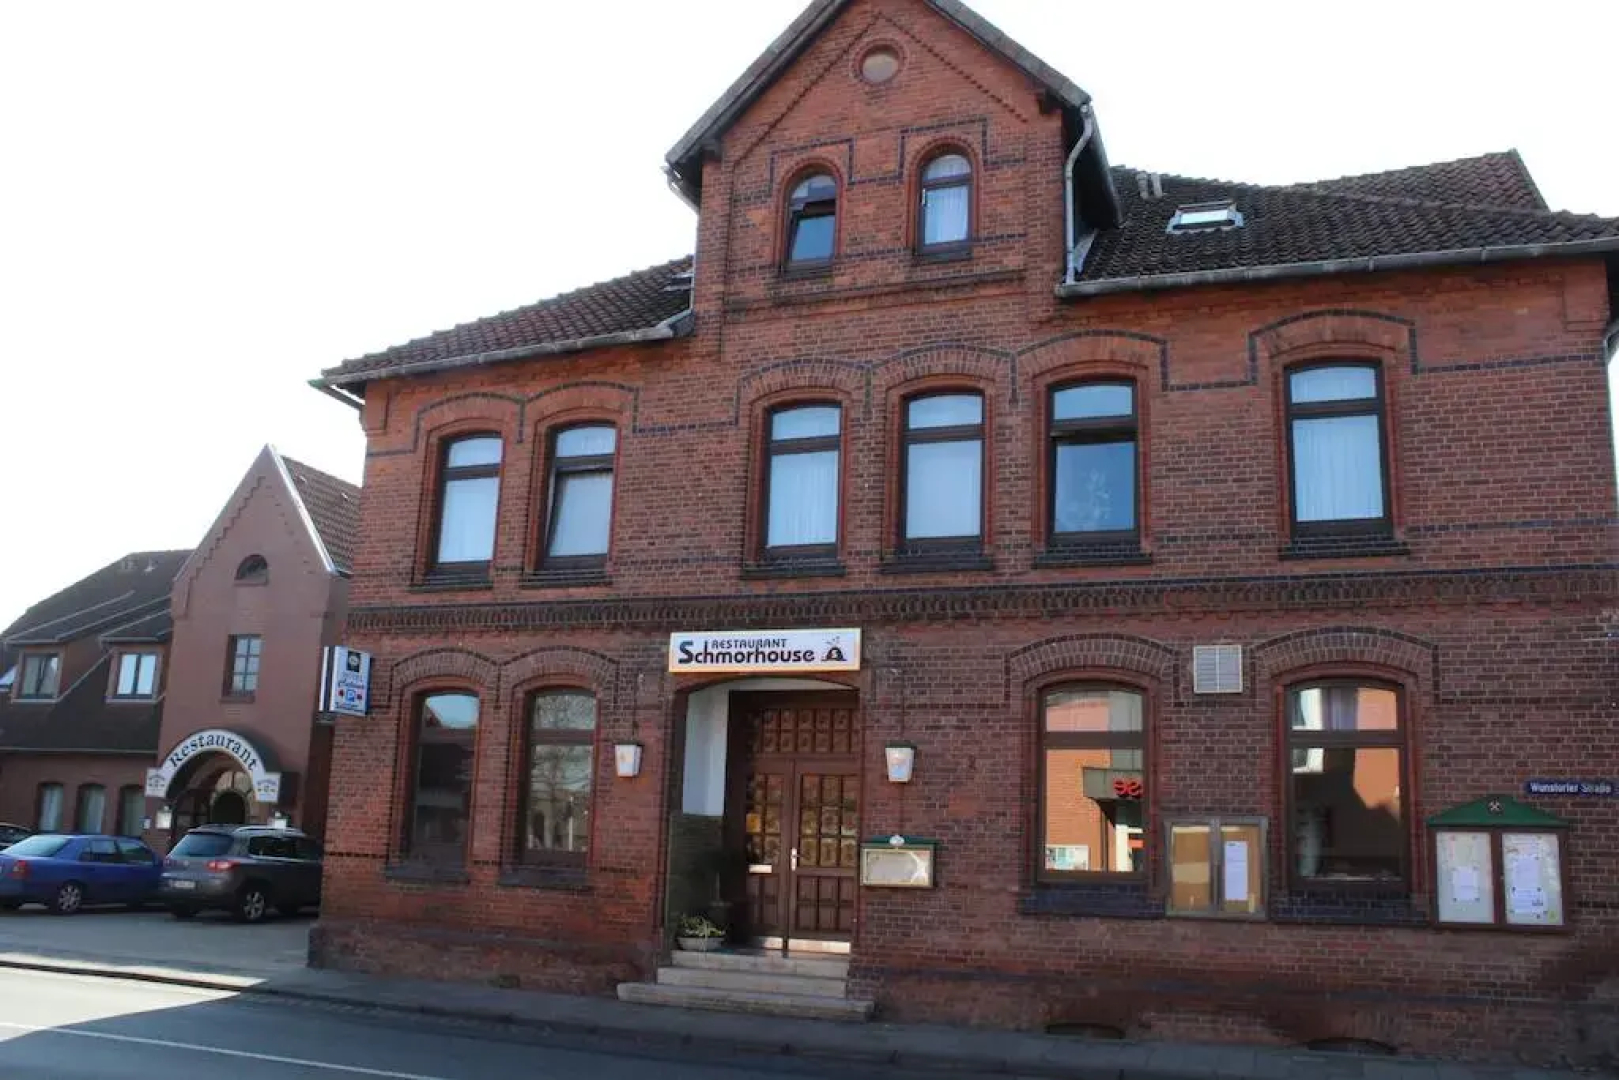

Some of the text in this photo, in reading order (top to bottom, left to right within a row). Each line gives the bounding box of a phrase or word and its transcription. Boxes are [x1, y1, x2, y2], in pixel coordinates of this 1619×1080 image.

[678, 640, 815, 664] Schmorhouse
[711, 638, 788, 649] RESTAURANT
[168, 733, 258, 771] Restaurant
